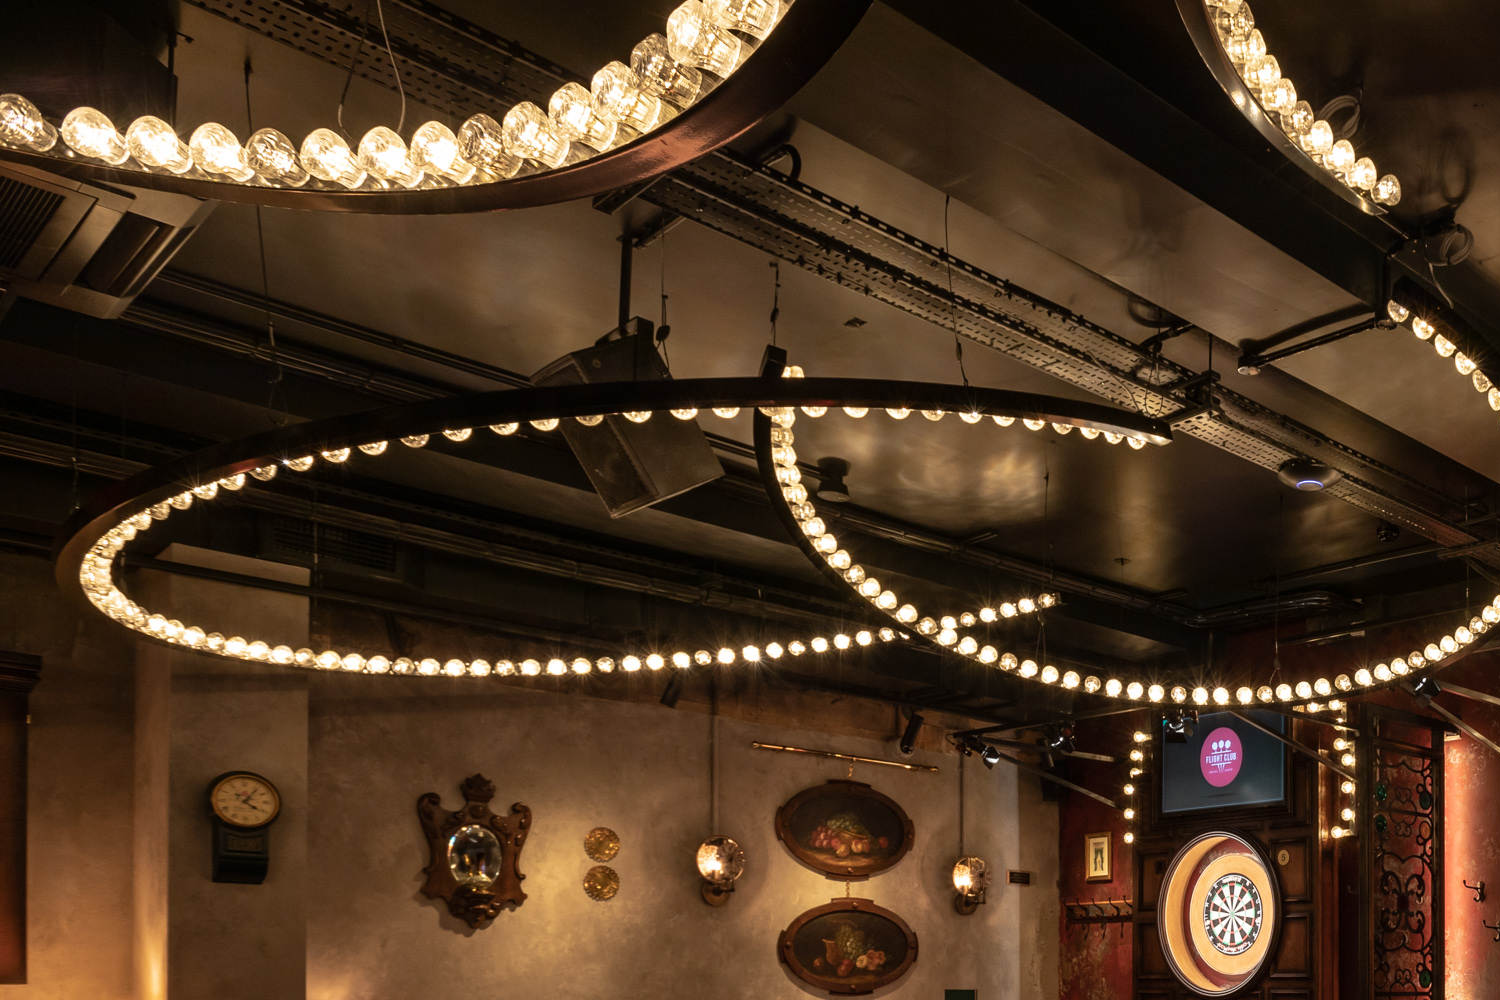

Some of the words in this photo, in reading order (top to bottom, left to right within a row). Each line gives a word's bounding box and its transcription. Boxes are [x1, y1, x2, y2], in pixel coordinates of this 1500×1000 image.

[1205, 754, 1223, 764] FLIGHT
[1223, 752, 1237, 761] CLUB
[1281, 853, 1286, 862] 5
